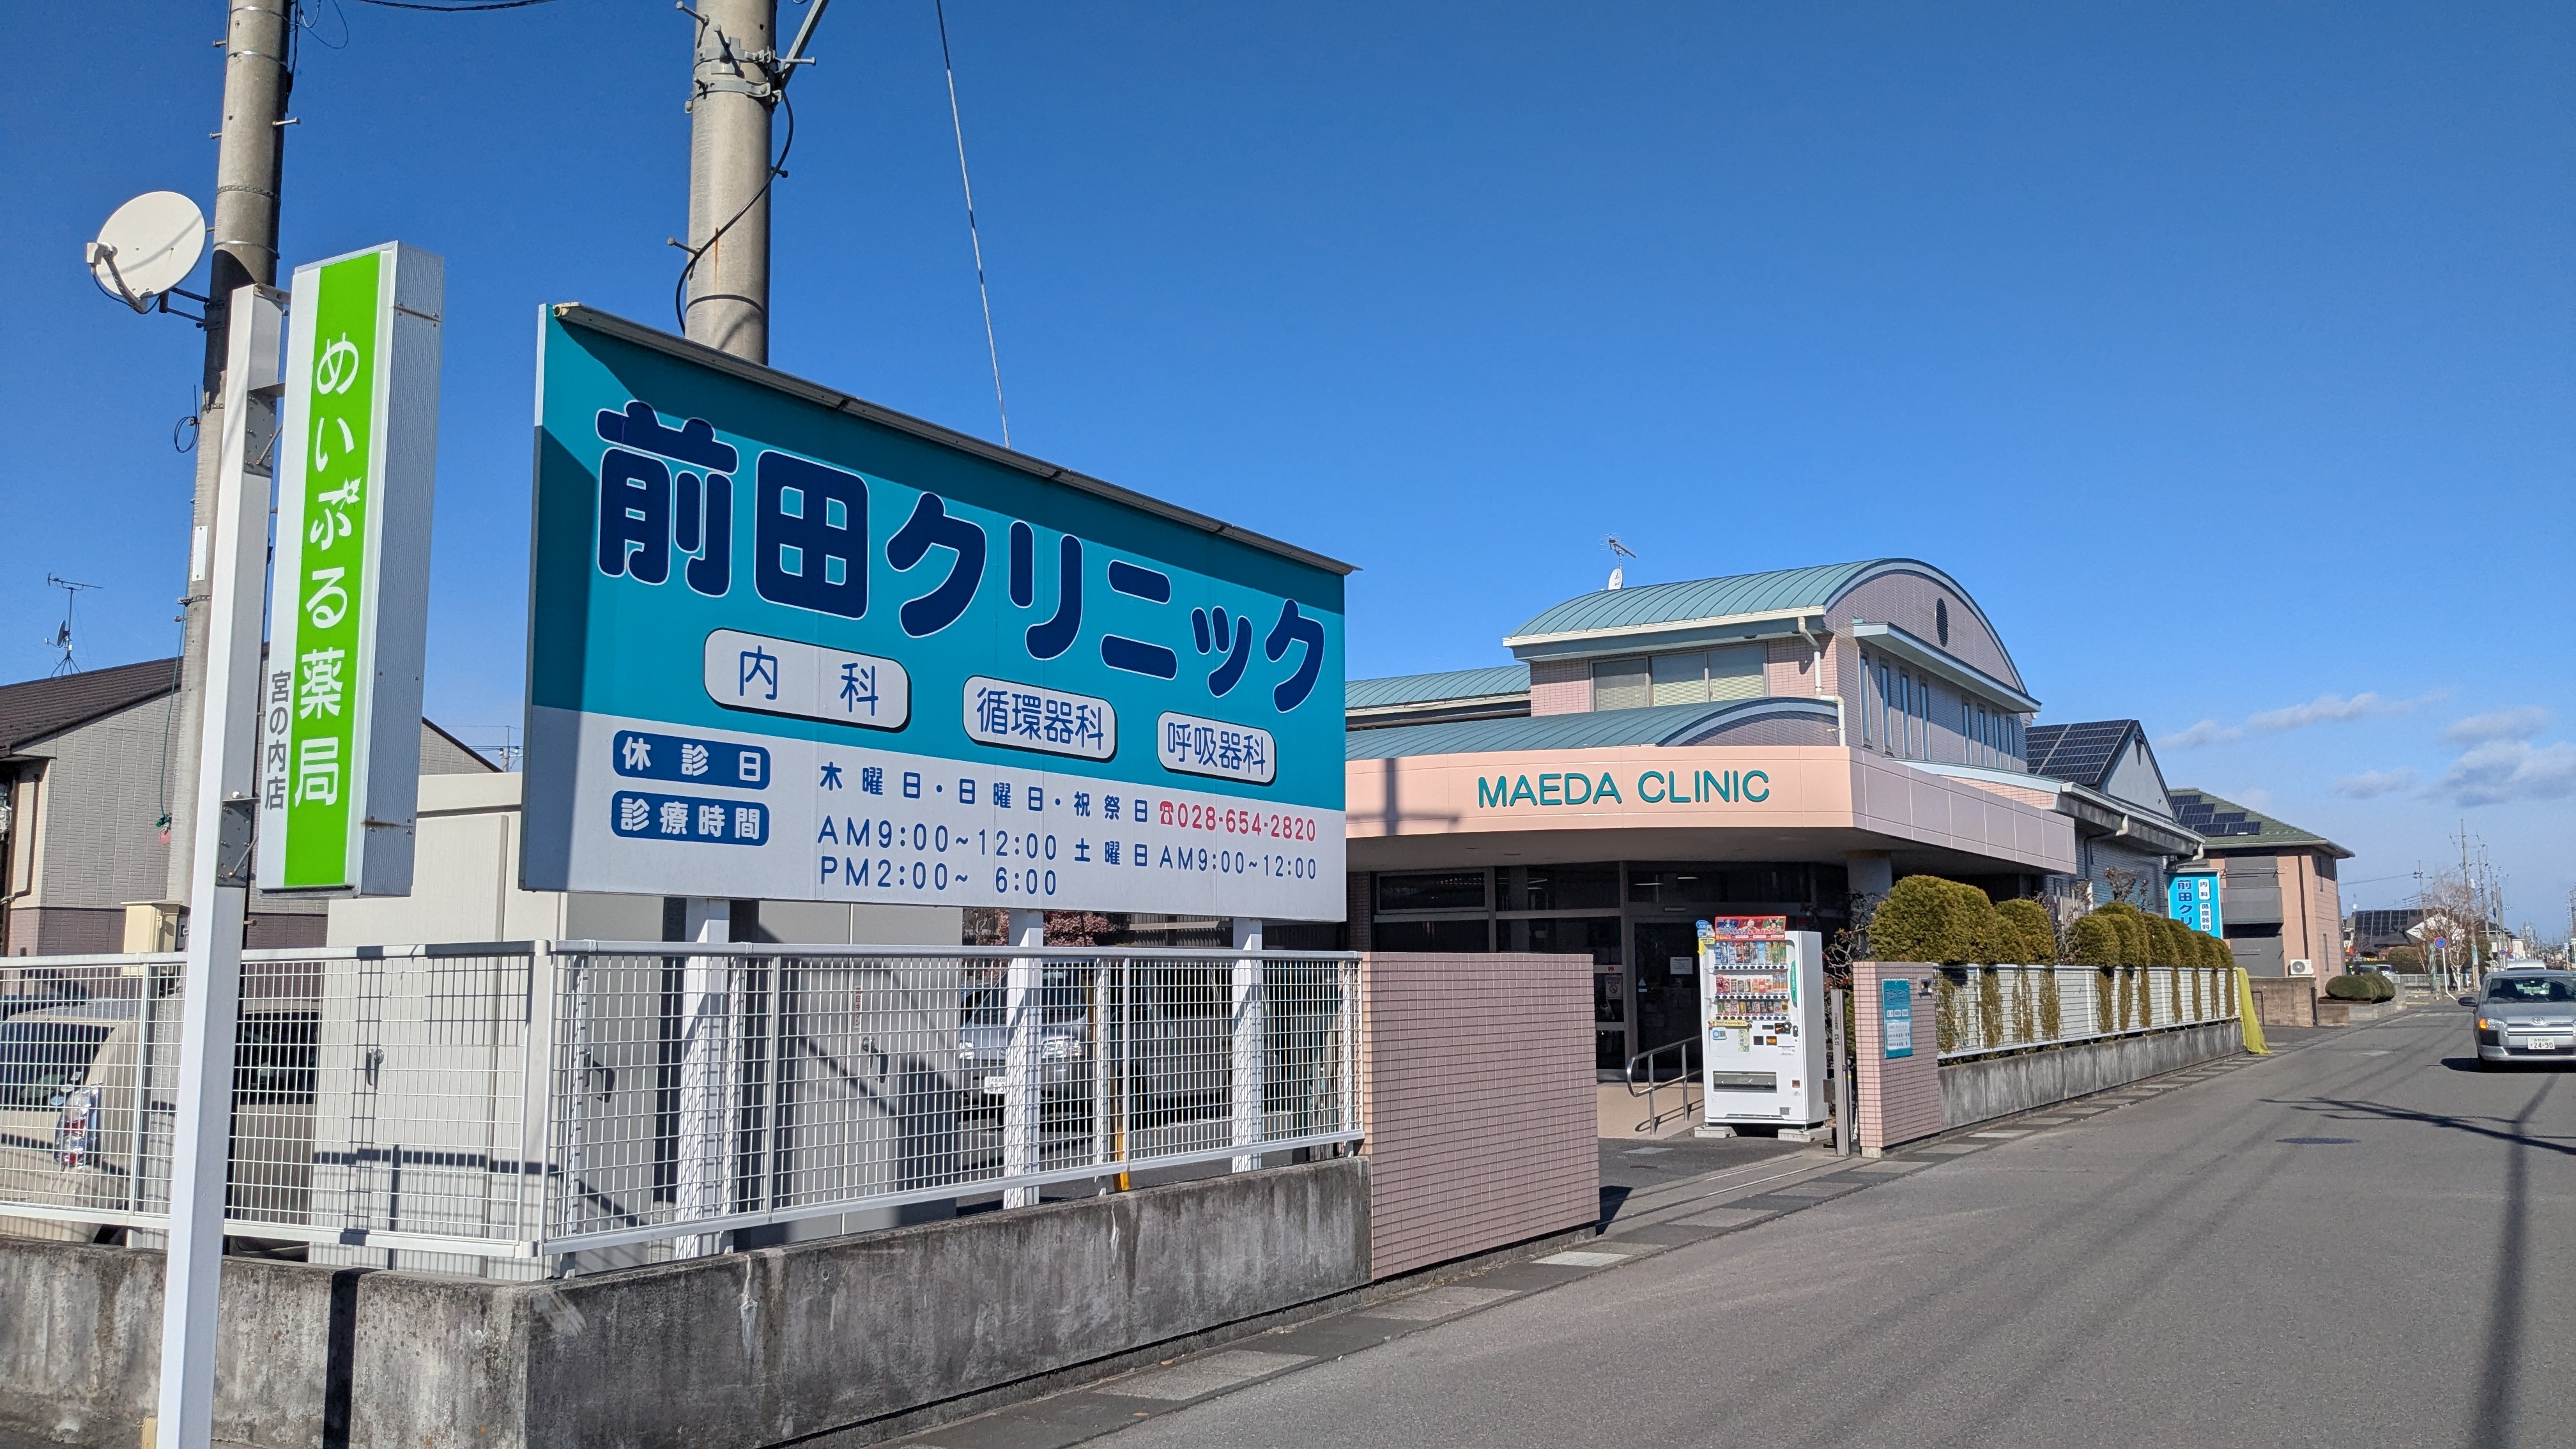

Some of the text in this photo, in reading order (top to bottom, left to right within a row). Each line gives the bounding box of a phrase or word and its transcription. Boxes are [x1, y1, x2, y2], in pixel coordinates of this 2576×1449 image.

[595, 400, 1325, 714] 前田クリニック
[739, 645, 879, 717] 内科
[264, 670, 292, 811] 宮の内店
[976, 686, 1105, 751] 循環器科
[622, 736, 762, 783] 休診日
[1167, 722, 1266, 776] 呼吸器科
[1478, 770, 1770, 808] MAEDA CLINIC
[620, 797, 761, 840] 診療時間
[1177, 803, 1317, 842] 028-654-2820
[1075, 838, 1148, 868] 土曜日
